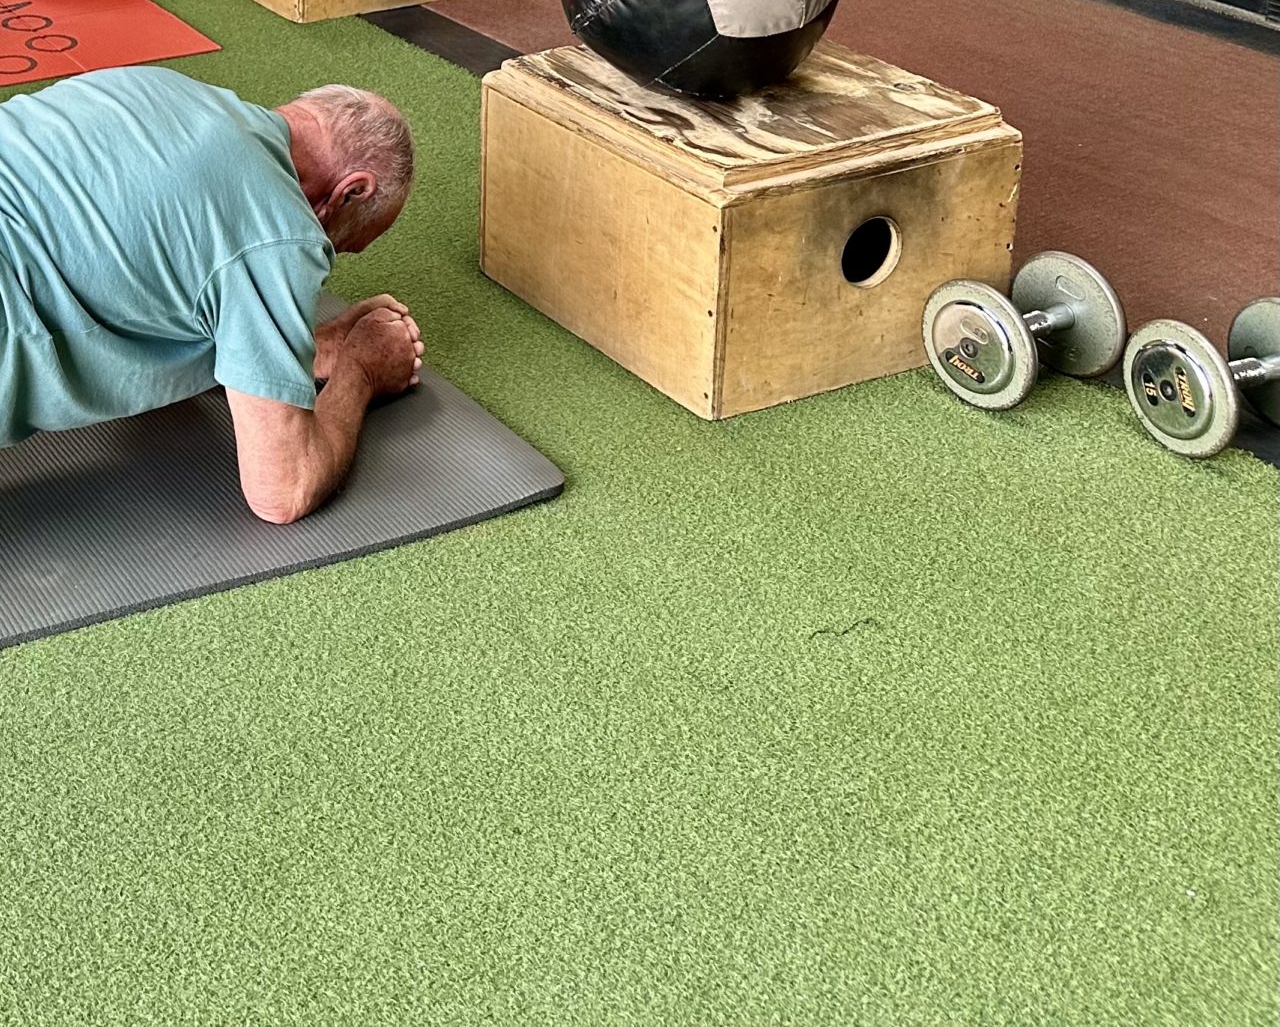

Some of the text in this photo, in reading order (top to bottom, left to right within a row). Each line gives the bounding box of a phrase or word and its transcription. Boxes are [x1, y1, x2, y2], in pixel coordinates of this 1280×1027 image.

[949, 357, 982, 381] TROY
[1143, 380, 1156, 398] 15
[1180, 372, 1195, 412] TROY
